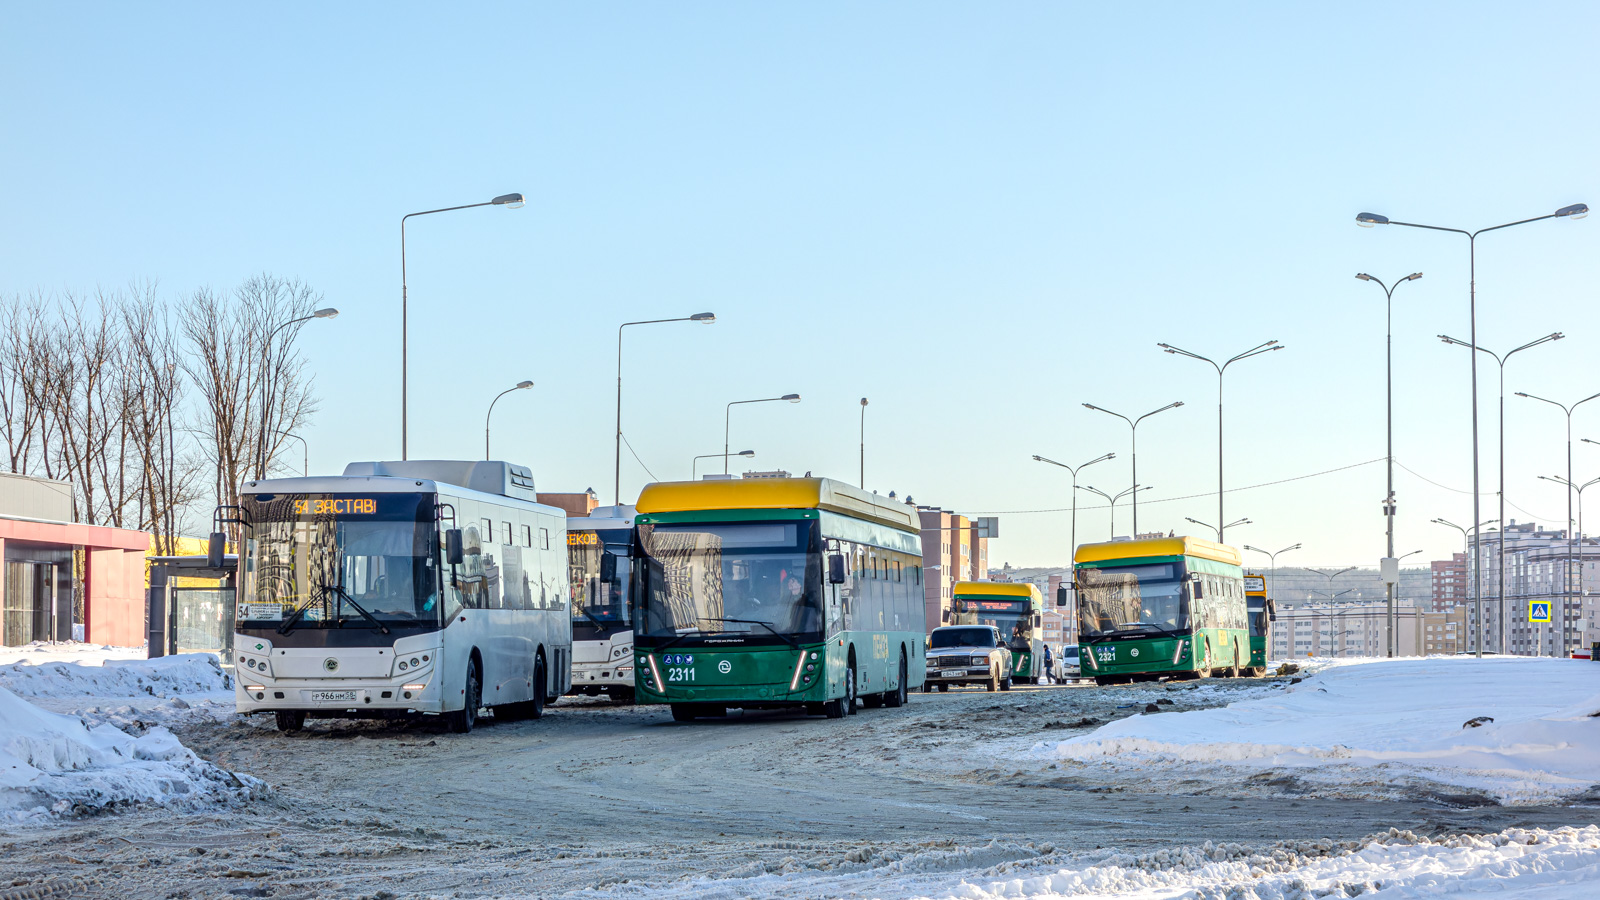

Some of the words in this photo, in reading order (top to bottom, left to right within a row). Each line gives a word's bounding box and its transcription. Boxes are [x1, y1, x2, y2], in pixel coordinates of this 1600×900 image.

[295, 499, 309, 514] 54
[238, 605, 249, 619] 54
[1098, 652, 1116, 662] 2321
[668, 667, 695, 682] 2311
